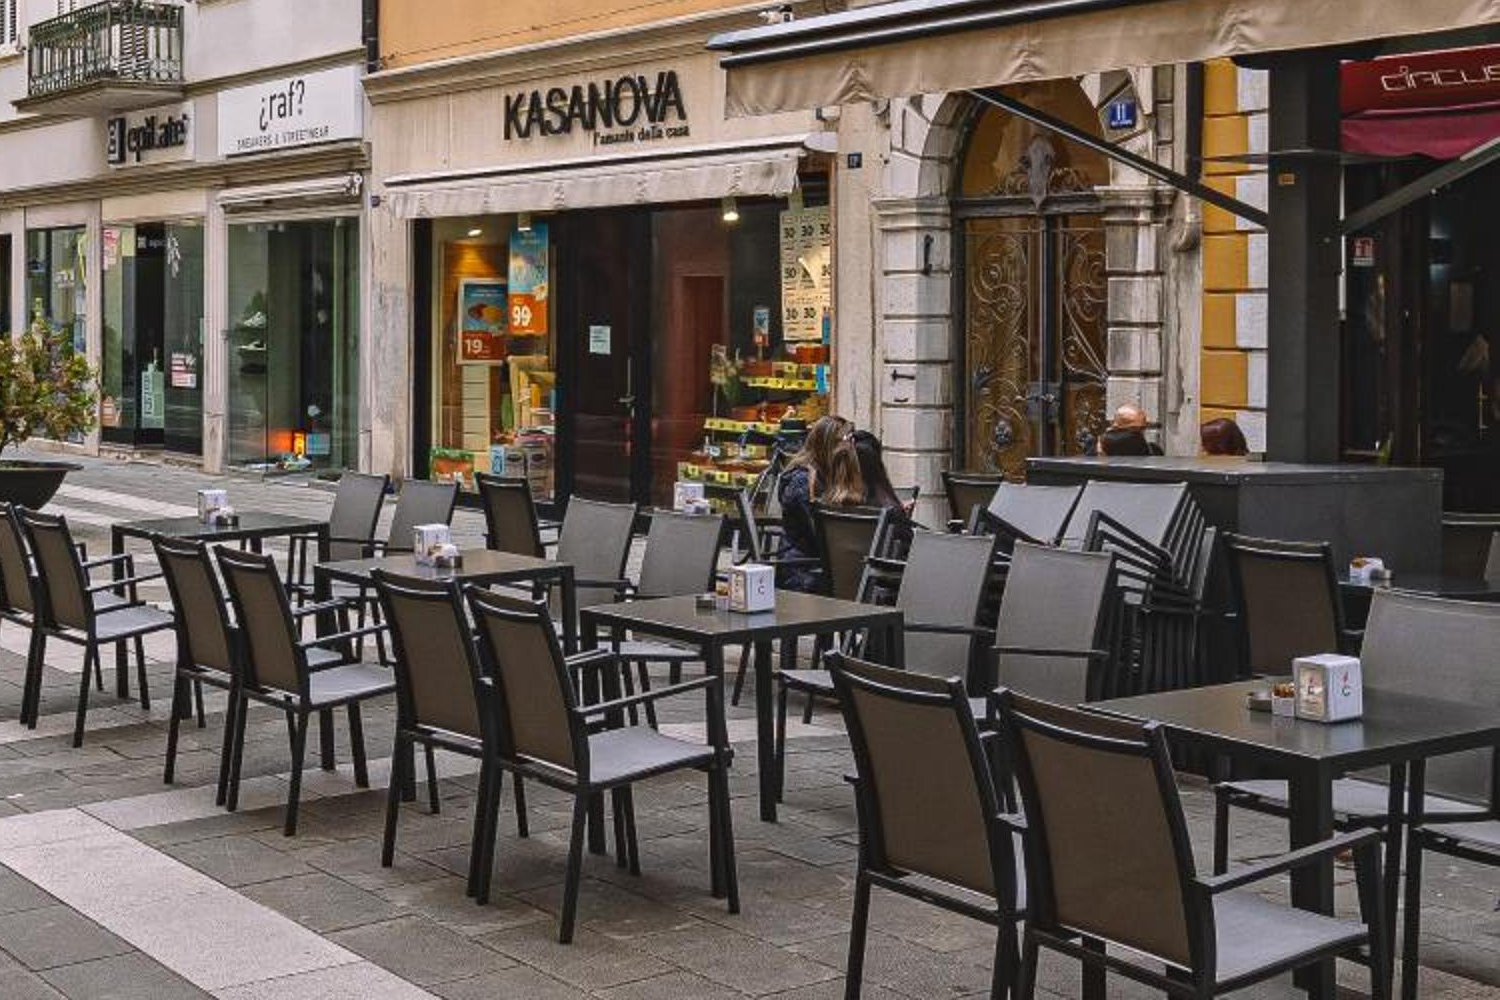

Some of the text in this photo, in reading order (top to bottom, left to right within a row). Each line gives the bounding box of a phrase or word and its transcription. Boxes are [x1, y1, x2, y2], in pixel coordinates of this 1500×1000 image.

[260, 80, 305, 131] ¿raf?
[504, 70, 686, 140] KASANOVA
[512, 305, 532, 327] 99
[465, 339, 483, 354] 19
